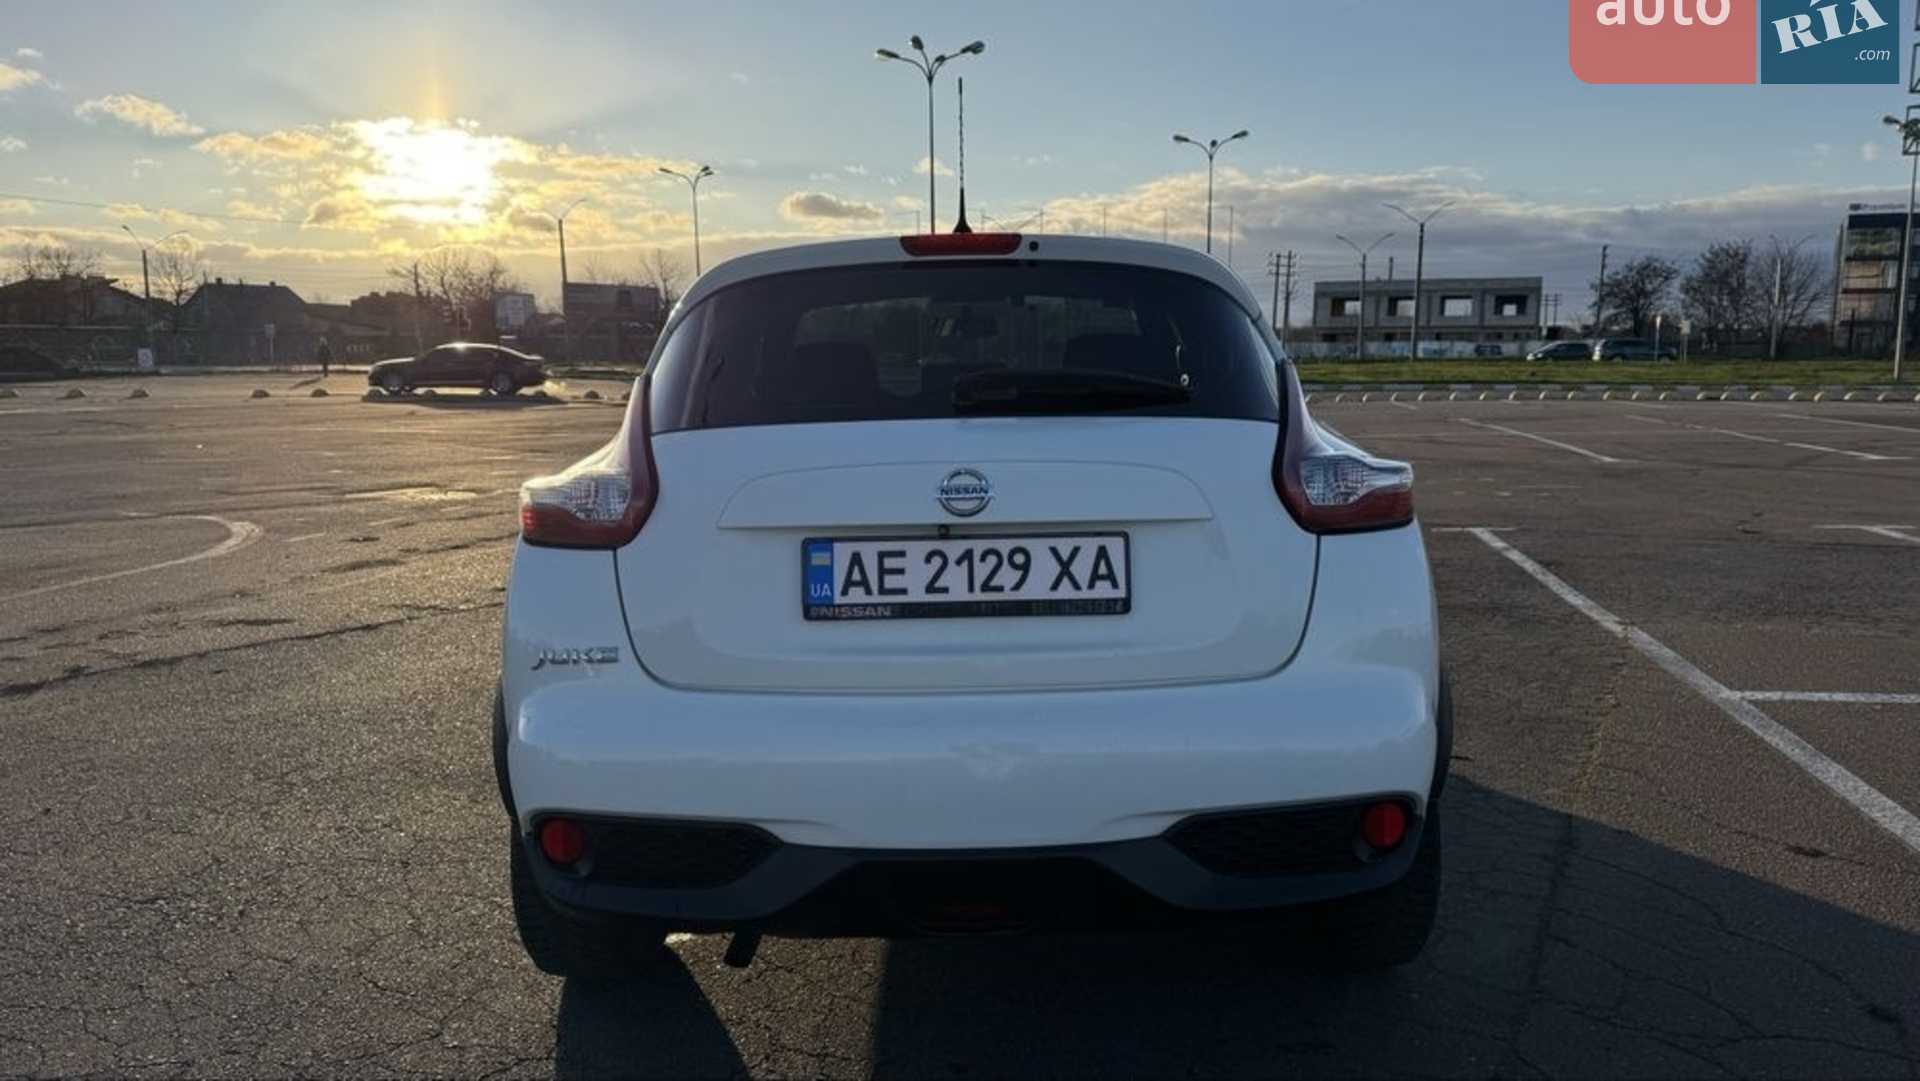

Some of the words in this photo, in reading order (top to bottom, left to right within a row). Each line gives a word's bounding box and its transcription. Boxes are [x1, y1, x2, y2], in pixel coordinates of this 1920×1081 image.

[940, 486, 989, 496] NISSAN
[840, 550, 908, 597] AE
[924, 546, 1031, 594] 2129
[1049, 544, 1120, 592] XA
[811, 583, 832, 598] UA
[531, 646, 619, 671] JUKE
